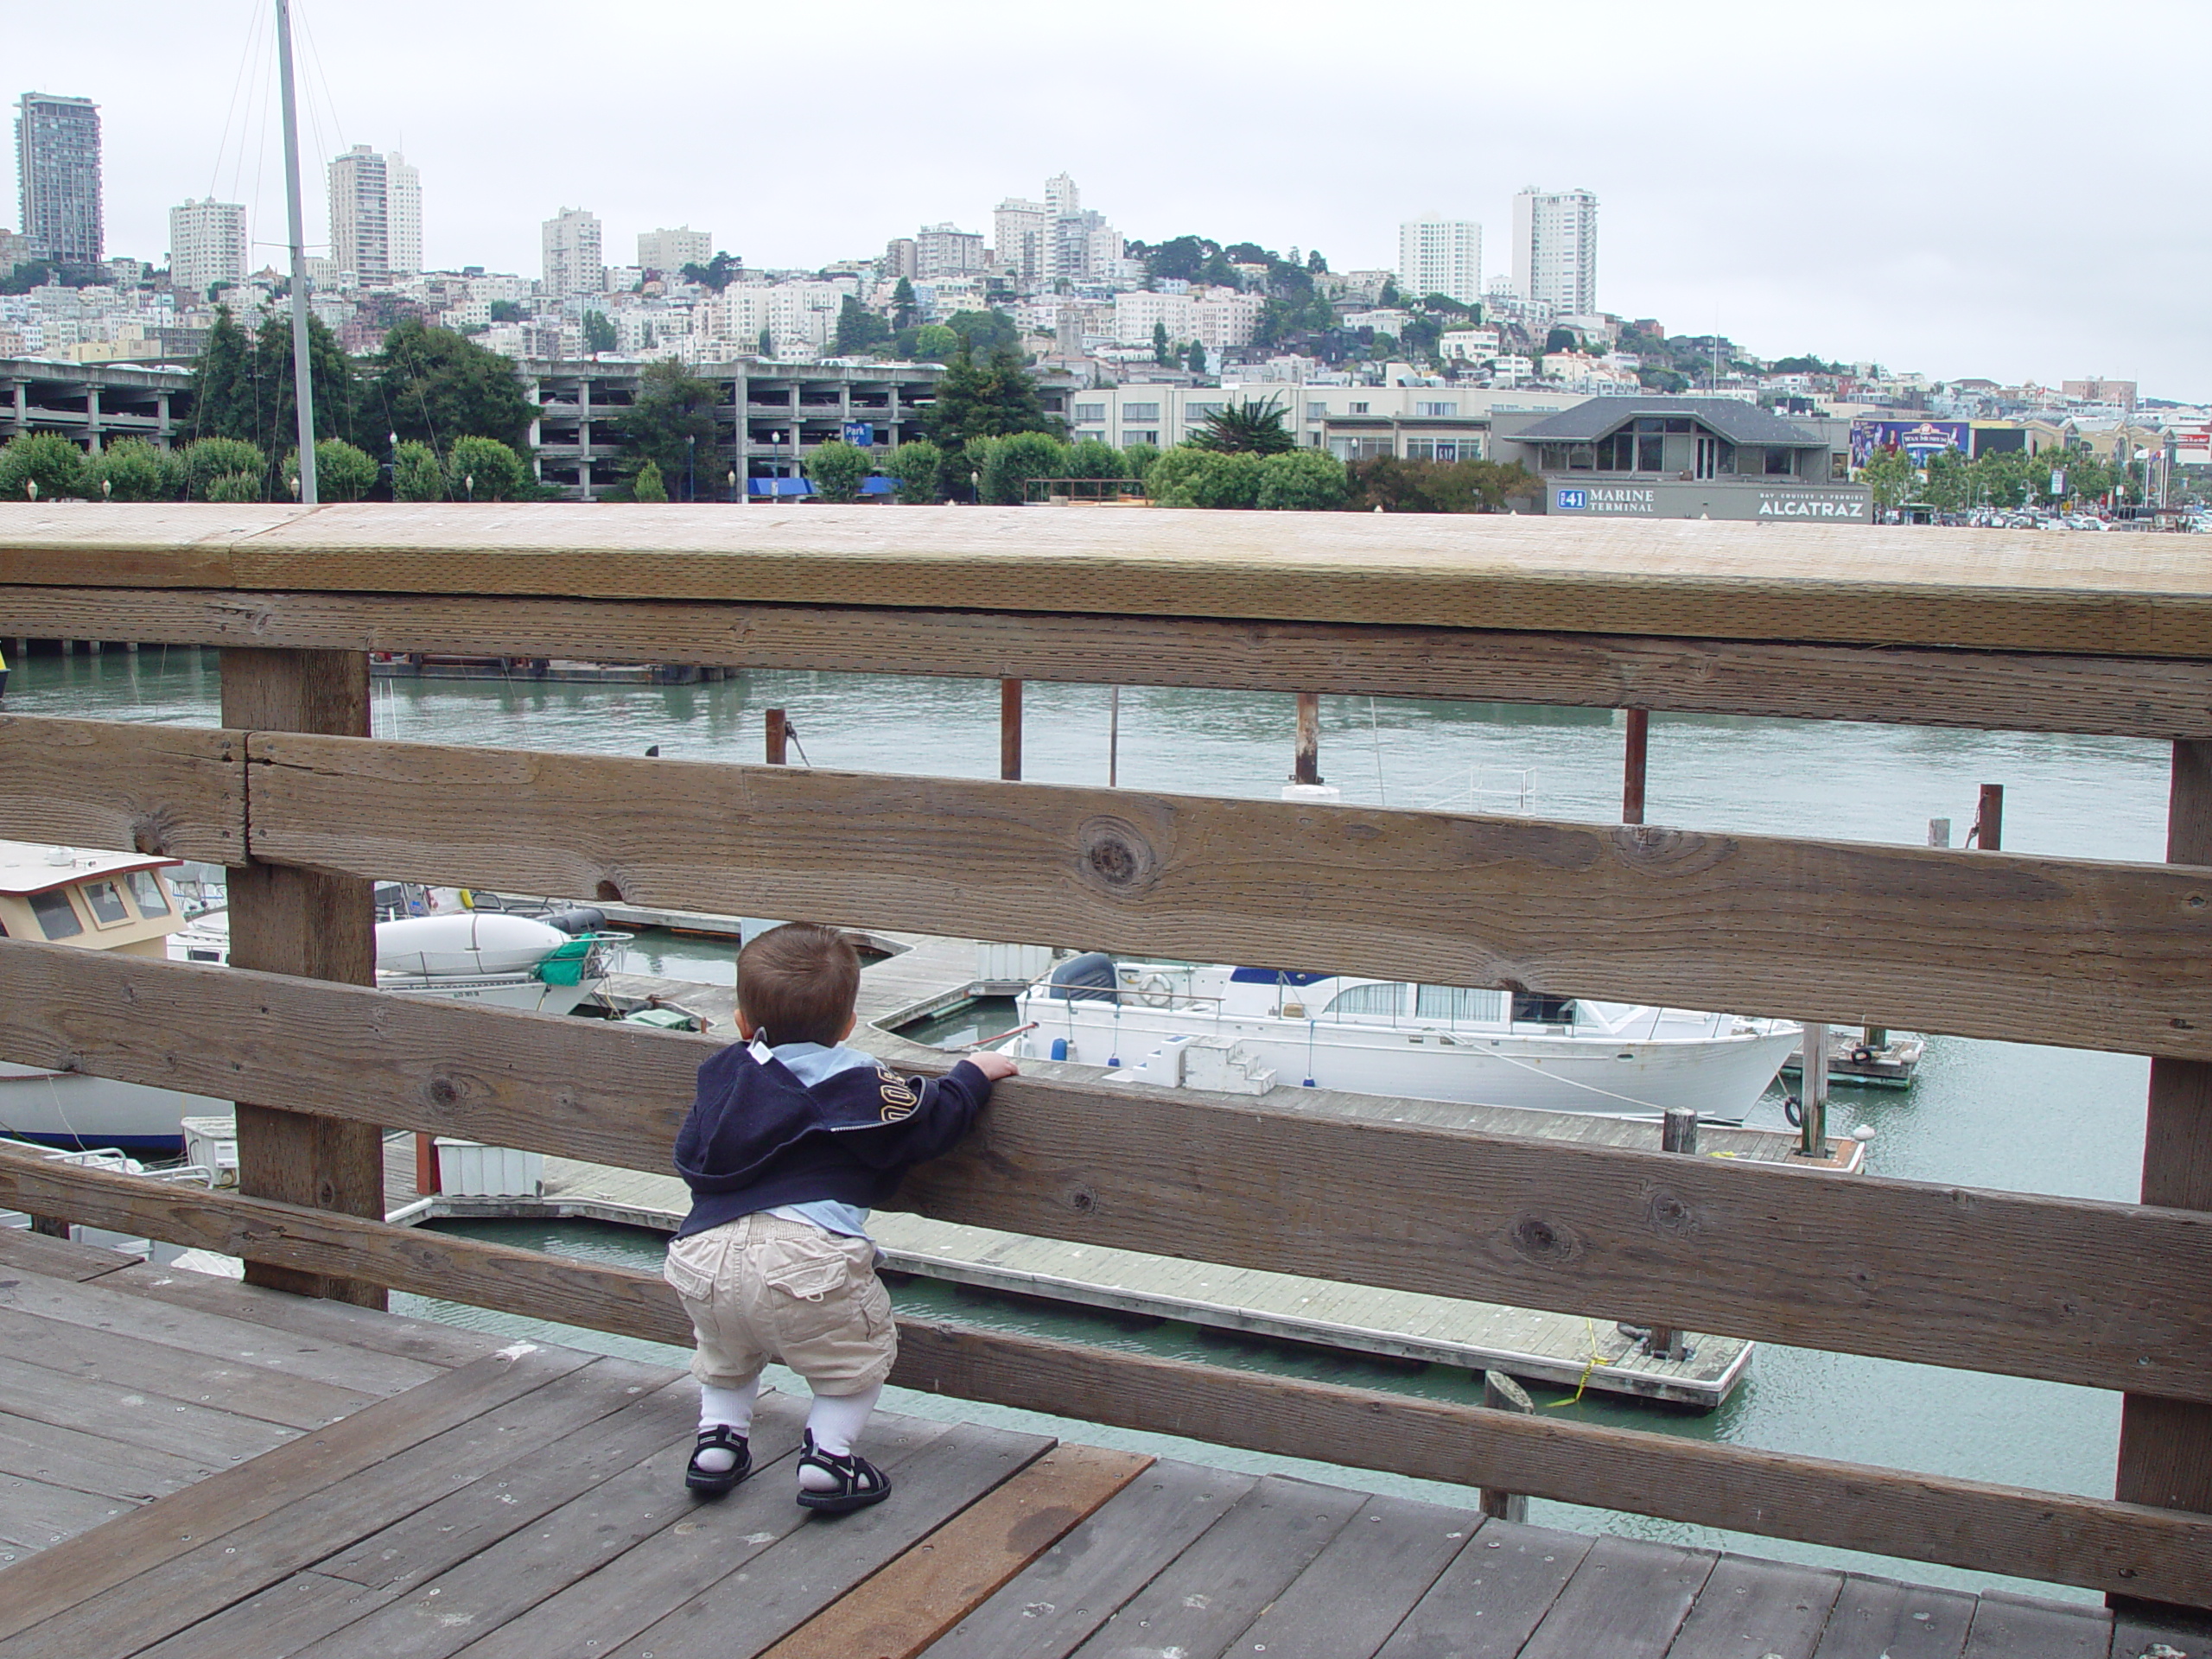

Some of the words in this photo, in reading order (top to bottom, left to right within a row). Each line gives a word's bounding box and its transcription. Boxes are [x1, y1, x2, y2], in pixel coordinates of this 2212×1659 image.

[846, 426, 865, 435] Park
[1566, 492, 1583, 506] 41
[1590, 489, 1655, 502] MARINE
[1590, 502, 1654, 512] TERMINAL
[1758, 501, 1864, 518] ALCATRAZ
